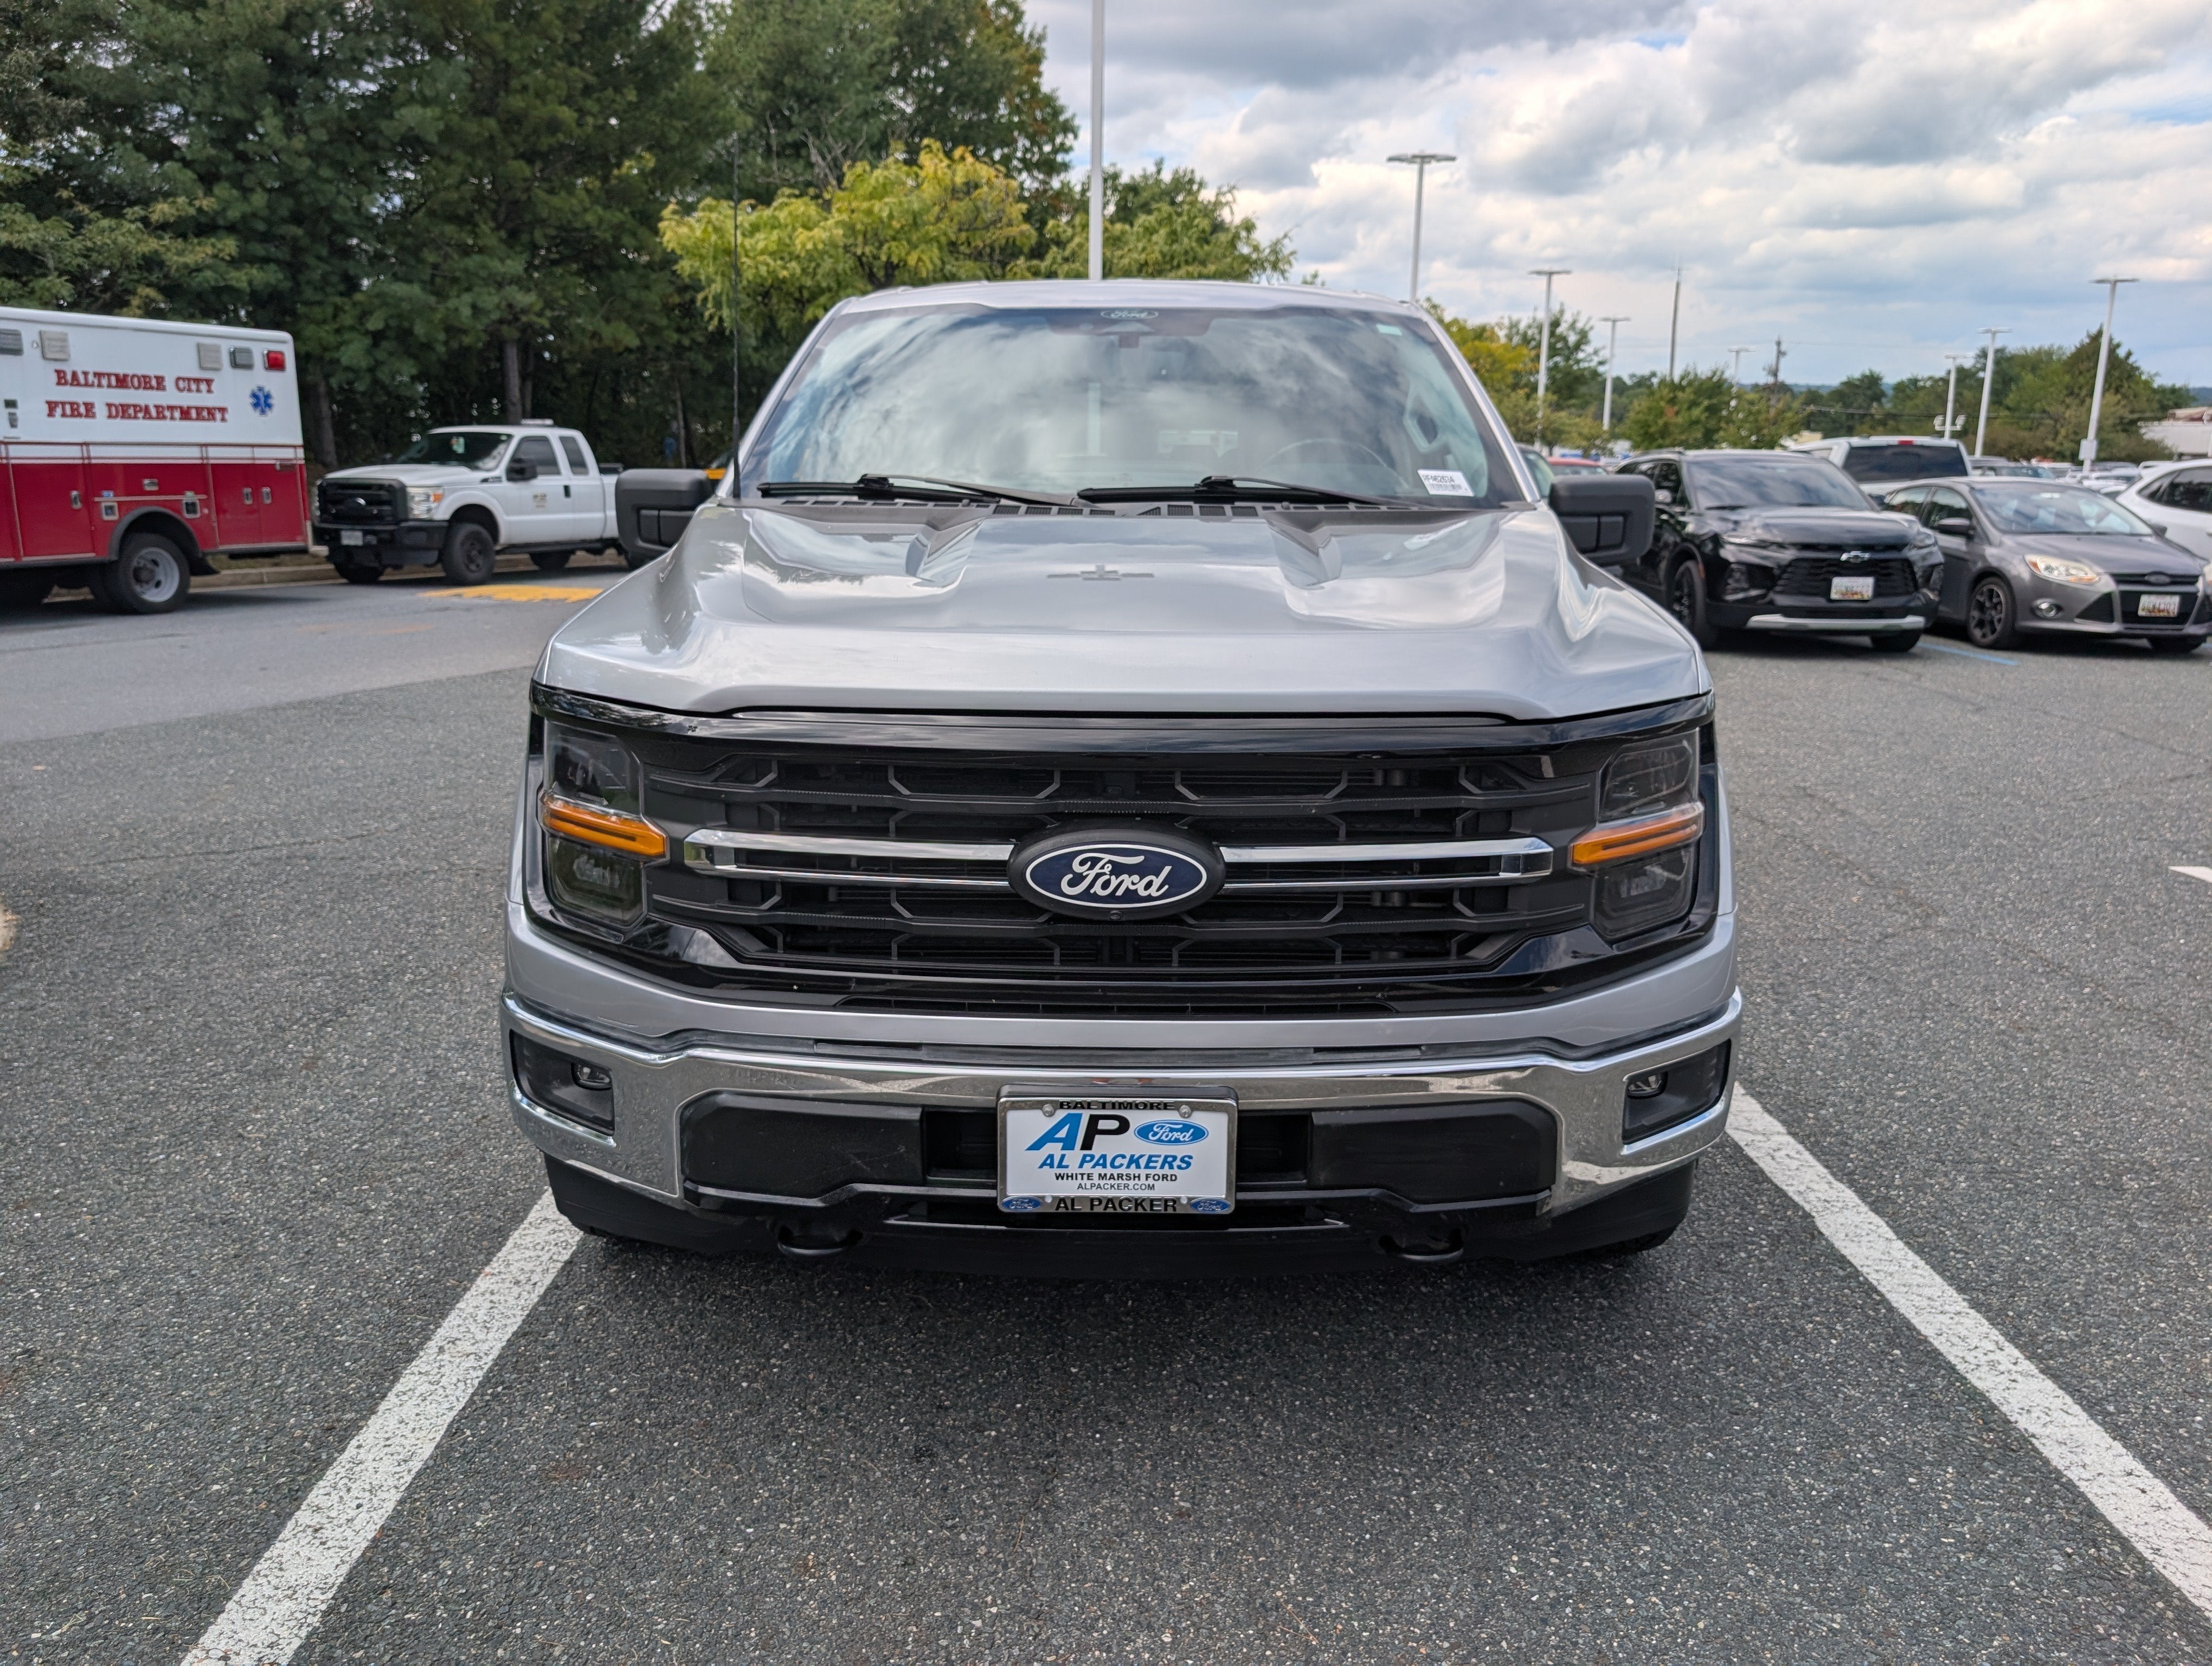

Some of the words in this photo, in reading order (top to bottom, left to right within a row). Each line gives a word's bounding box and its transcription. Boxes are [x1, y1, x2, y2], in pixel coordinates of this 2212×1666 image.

[55, 369, 167, 392] BALTIMORE
[175, 376, 215, 393] CITY
[46, 400, 97, 419] FIRE
[105, 403, 229, 422] DEPARTMENT
[1060, 853, 1173, 897] Ford
[1059, 1100, 1175, 1110] BALTIMORE
[1024, 1112, 1131, 1151] AP
[1148, 1124, 1194, 1142] Ford
[1038, 1154, 1070, 1169] AL
[1078, 1154, 1194, 1170] PACKERS
[1054, 1172, 1094, 1181] WHITE
[1098, 1173, 1141, 1181] MARSH
[1145, 1174, 1178, 1182] FORD
[1077, 1182, 1155, 1191] ALPACKER.COM
[1009, 1198, 1034, 1209] Ford
[1054, 1197, 1082, 1211] AL
[1089, 1197, 1178, 1212] PACKER
[1197, 1200, 1223, 1210] Ford
